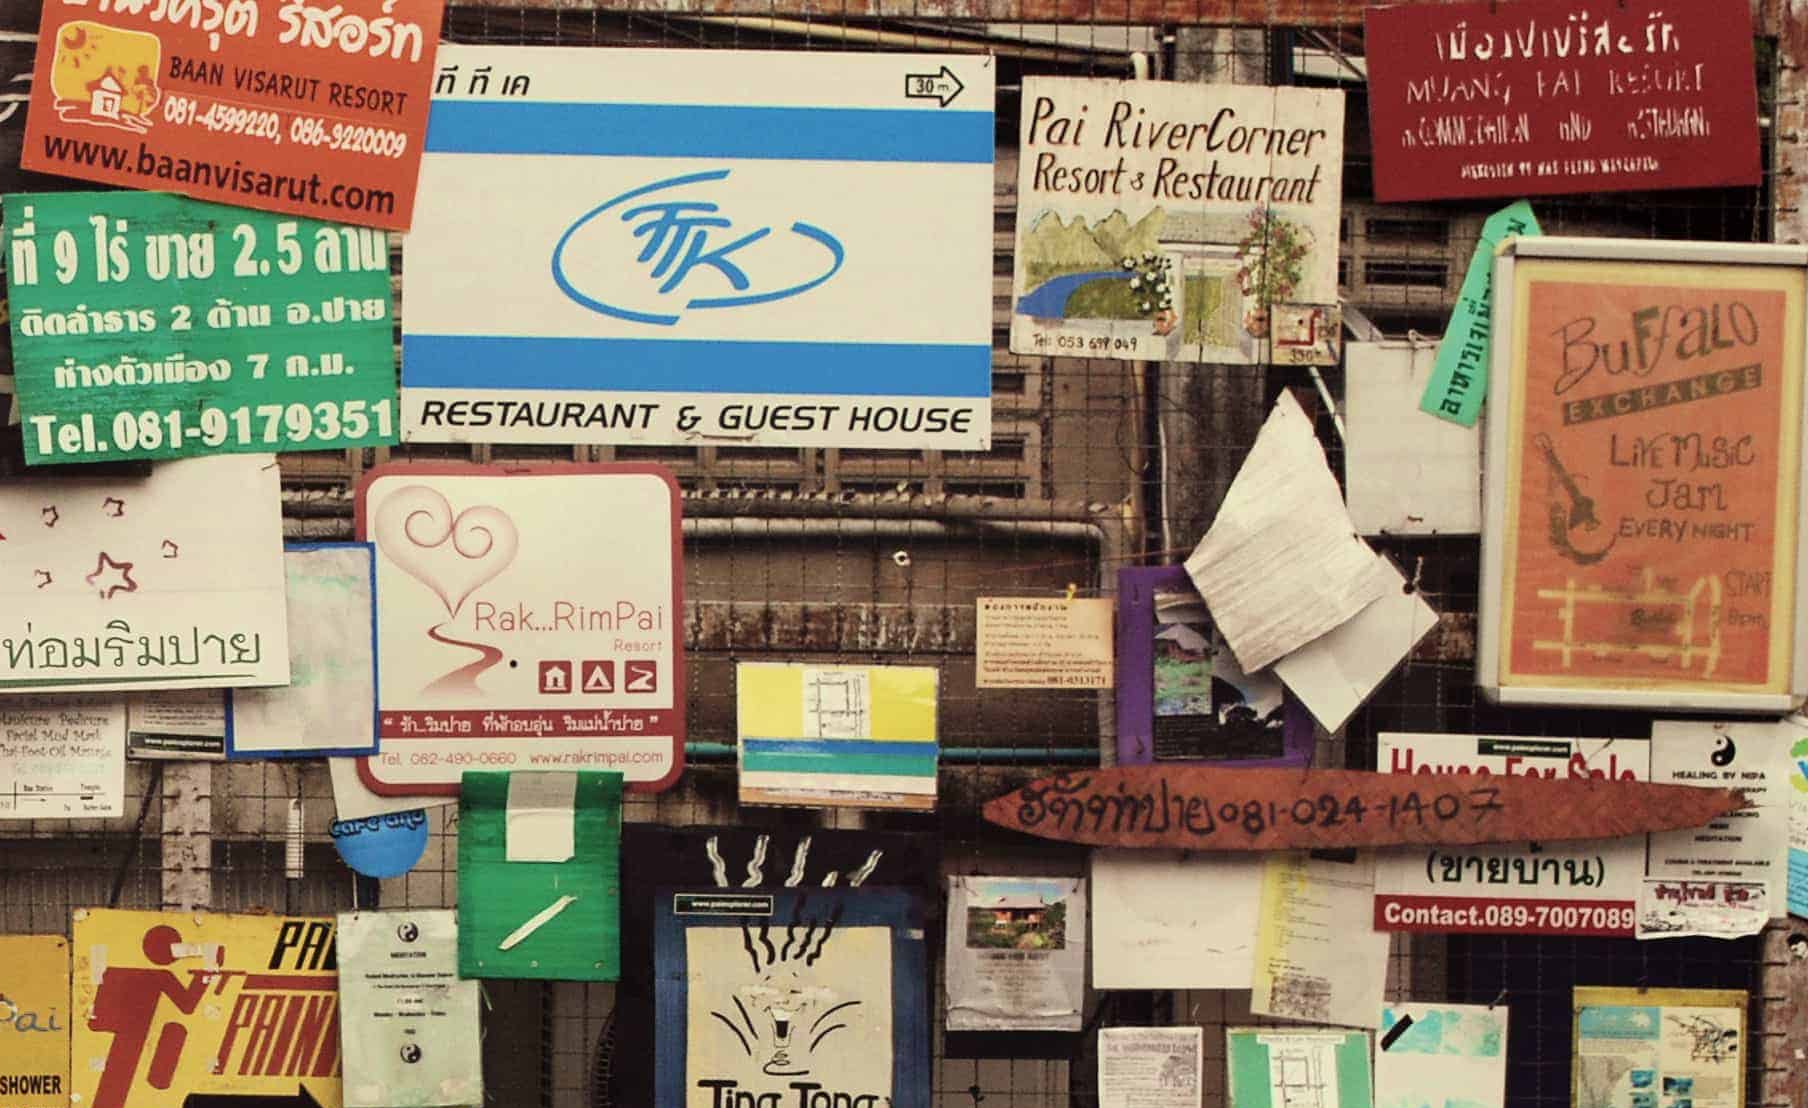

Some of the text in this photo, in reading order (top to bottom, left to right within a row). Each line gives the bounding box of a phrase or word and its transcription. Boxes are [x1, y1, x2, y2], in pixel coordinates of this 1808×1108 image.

[169, 56, 408, 115] BAAN VISARUT RESORT
[436, 65, 530, 97] ที ที เค
[915, 78, 934, 96] 30
[164, 96, 408, 158] 081-4599220, 086-9220009
[1028, 97, 1327, 157] Pai RiverCorner
[43, 134, 395, 214] www.baanvisarut.com
[1033, 156, 1322, 205] Resort Restaurant
[12, 206, 303, 286] ที่ 9 ไร่ ขาย 2.5
[20, 297, 385, 337] ติดลำธาร 2 ด้าน อ.ปาย
[1058, 336, 1138, 351] 053 049
[54, 352, 355, 389] ห่างตัวเมือง 7 ก.ม.
[1565, 367, 1762, 424] EXCHANGE
[31, 400, 392, 455] Tel.081-9179351
[421, 402, 972, 434] RESTAURANT & GUEST HOUSE
[1618, 516, 1754, 544] EVERY NIGHT
[529, 752, 663, 767] www.rakrimpai.com
[1742, 772, 1766, 780] NIPA
[1219, 787, 1505, 837] 081-024-1407
[1426, 839, 1605, 888] (ขายบ้าน)
[1384, 902, 1634, 928] Contact.089-7007089
[0, 1075, 62, 1096] SHOWER
